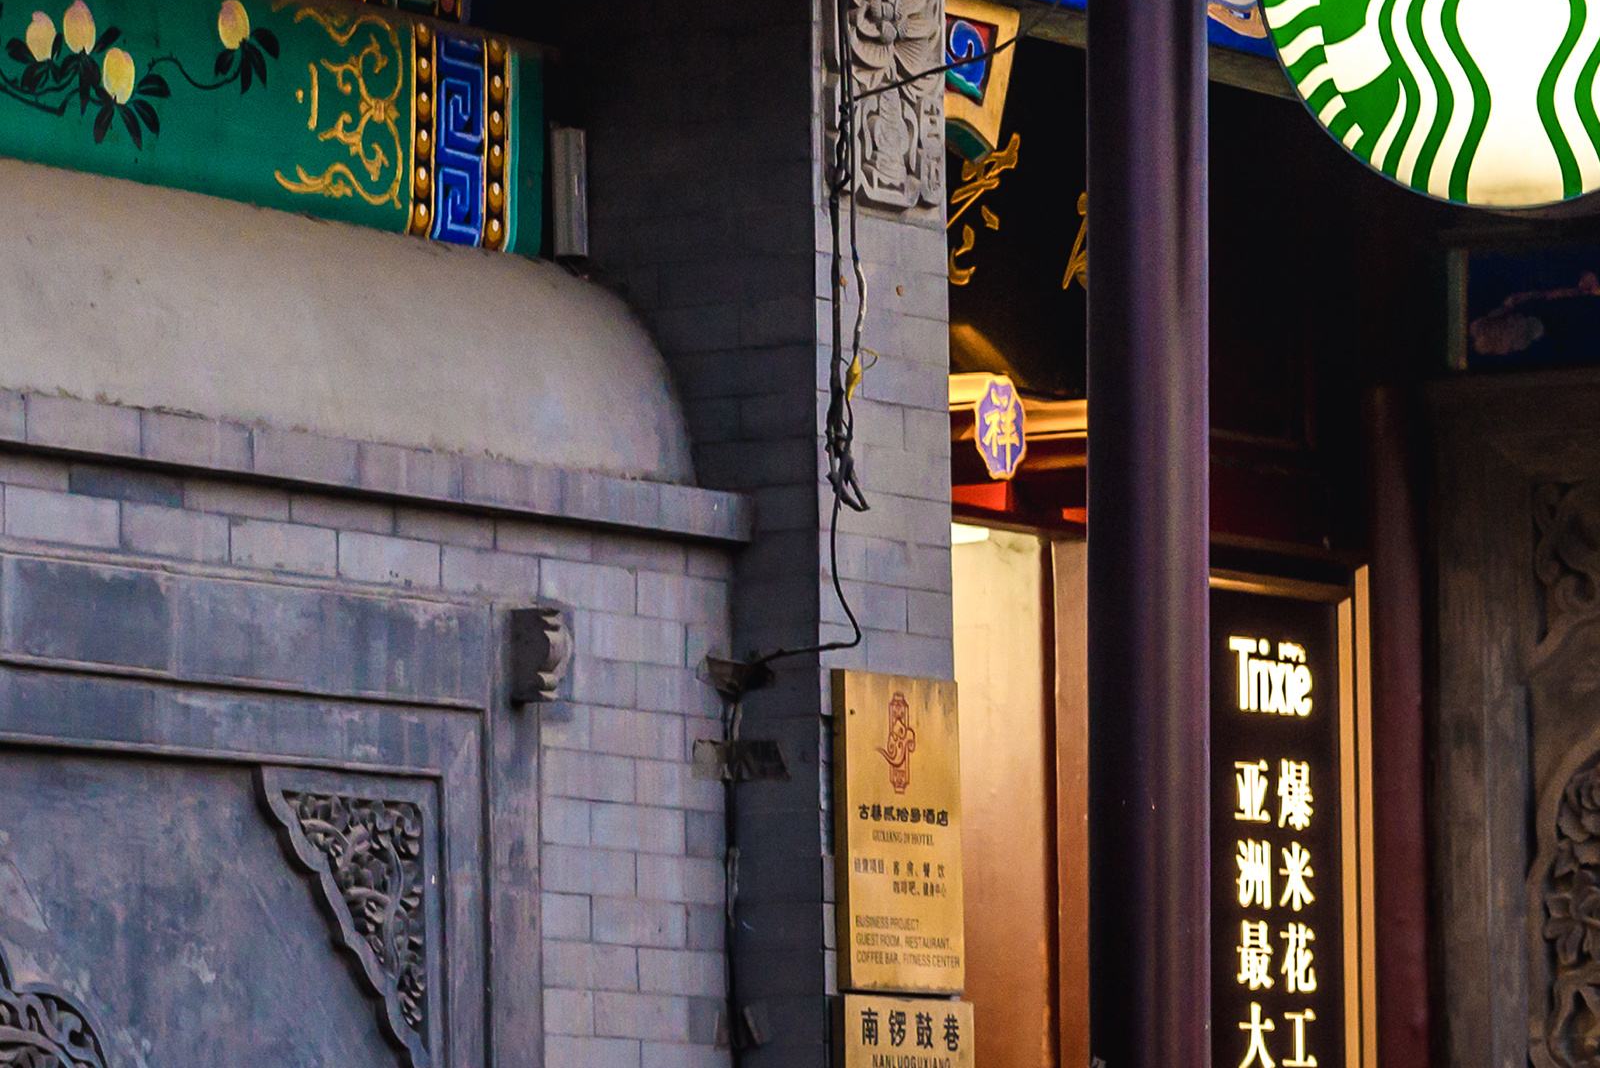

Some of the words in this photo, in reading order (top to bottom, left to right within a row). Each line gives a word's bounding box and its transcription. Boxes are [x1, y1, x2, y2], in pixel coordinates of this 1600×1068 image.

[981, 388, 1020, 474] 祥
[1229, 635, 1313, 717] Trixie
[911, 832, 935, 847] HOTEL
[855, 914, 889, 929] BUSINESS
[1233, 758, 1276, 1068] 亚洲最大
[1276, 757, 1319, 1068] 爆米花工
[855, 932, 879, 946] GUEST
[856, 950, 884, 964] COFFEE
[902, 952, 931, 966] FITNESS
[931, 954, 960, 968] CENTER
[861, 1006, 960, 1052] 南锣鼓巷
